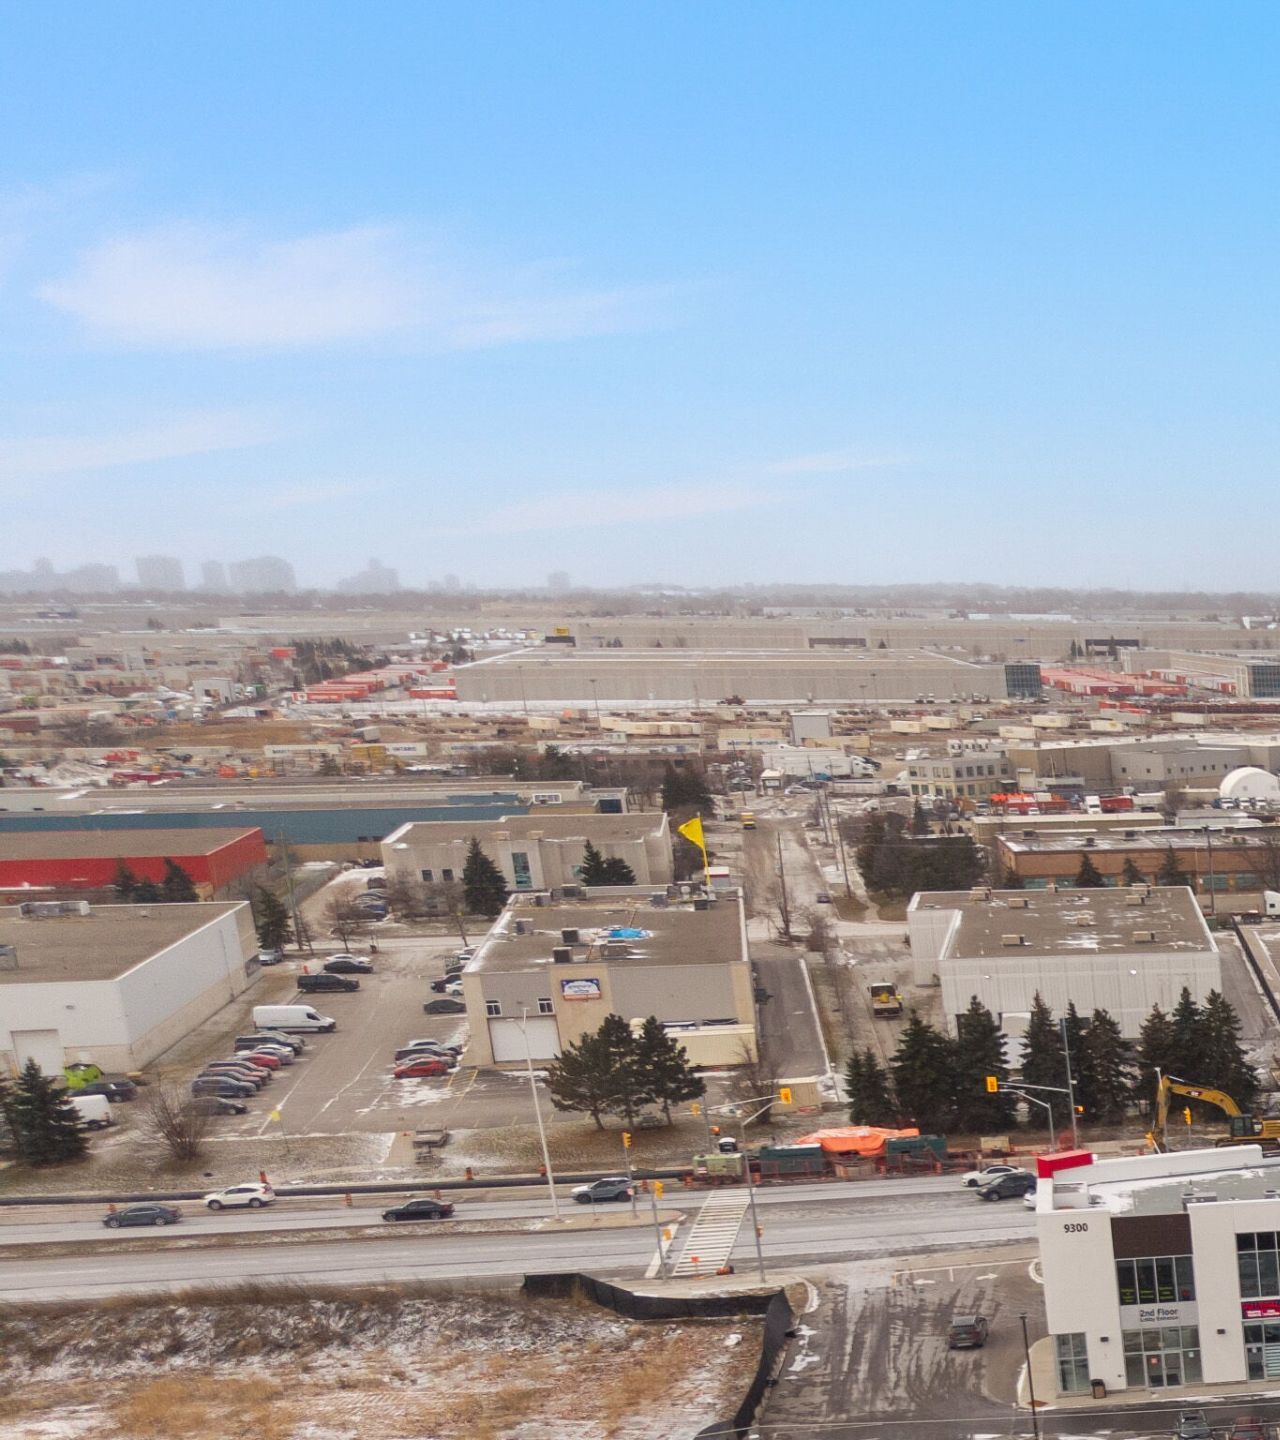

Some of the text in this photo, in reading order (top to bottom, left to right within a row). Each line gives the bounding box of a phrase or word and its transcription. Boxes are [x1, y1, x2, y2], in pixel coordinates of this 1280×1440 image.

[1063, 1222, 1089, 1234] 9300
[1140, 1308, 1179, 1318] 2nd Floor
